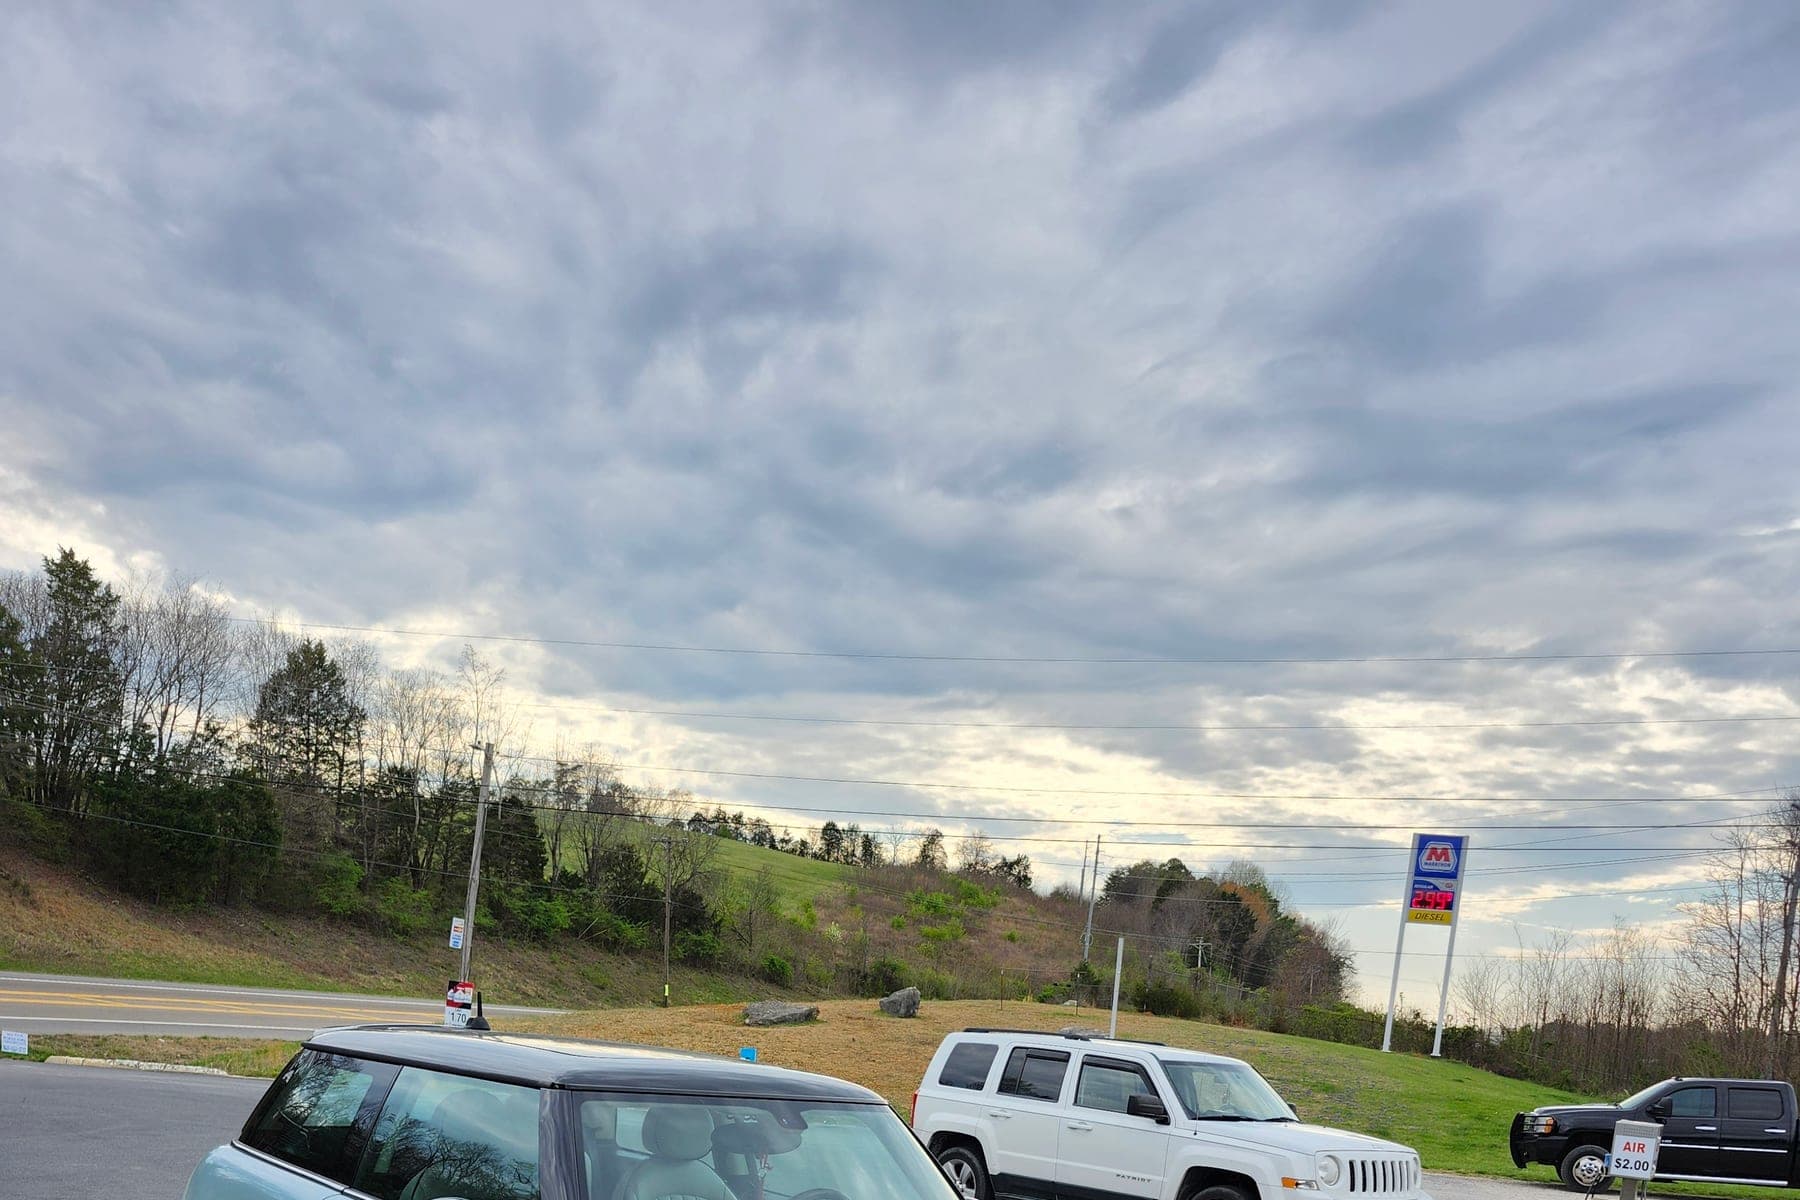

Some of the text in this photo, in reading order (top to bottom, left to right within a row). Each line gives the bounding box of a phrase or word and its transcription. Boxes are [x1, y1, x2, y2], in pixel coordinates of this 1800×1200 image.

[1426, 847, 1450, 862] M
[1414, 912, 1445, 921] DIESEL
[1622, 1141, 1646, 1154] AIR
[1614, 1158, 1650, 1172] $2.00
[1116, 1173, 1152, 1183] PATRIOT
